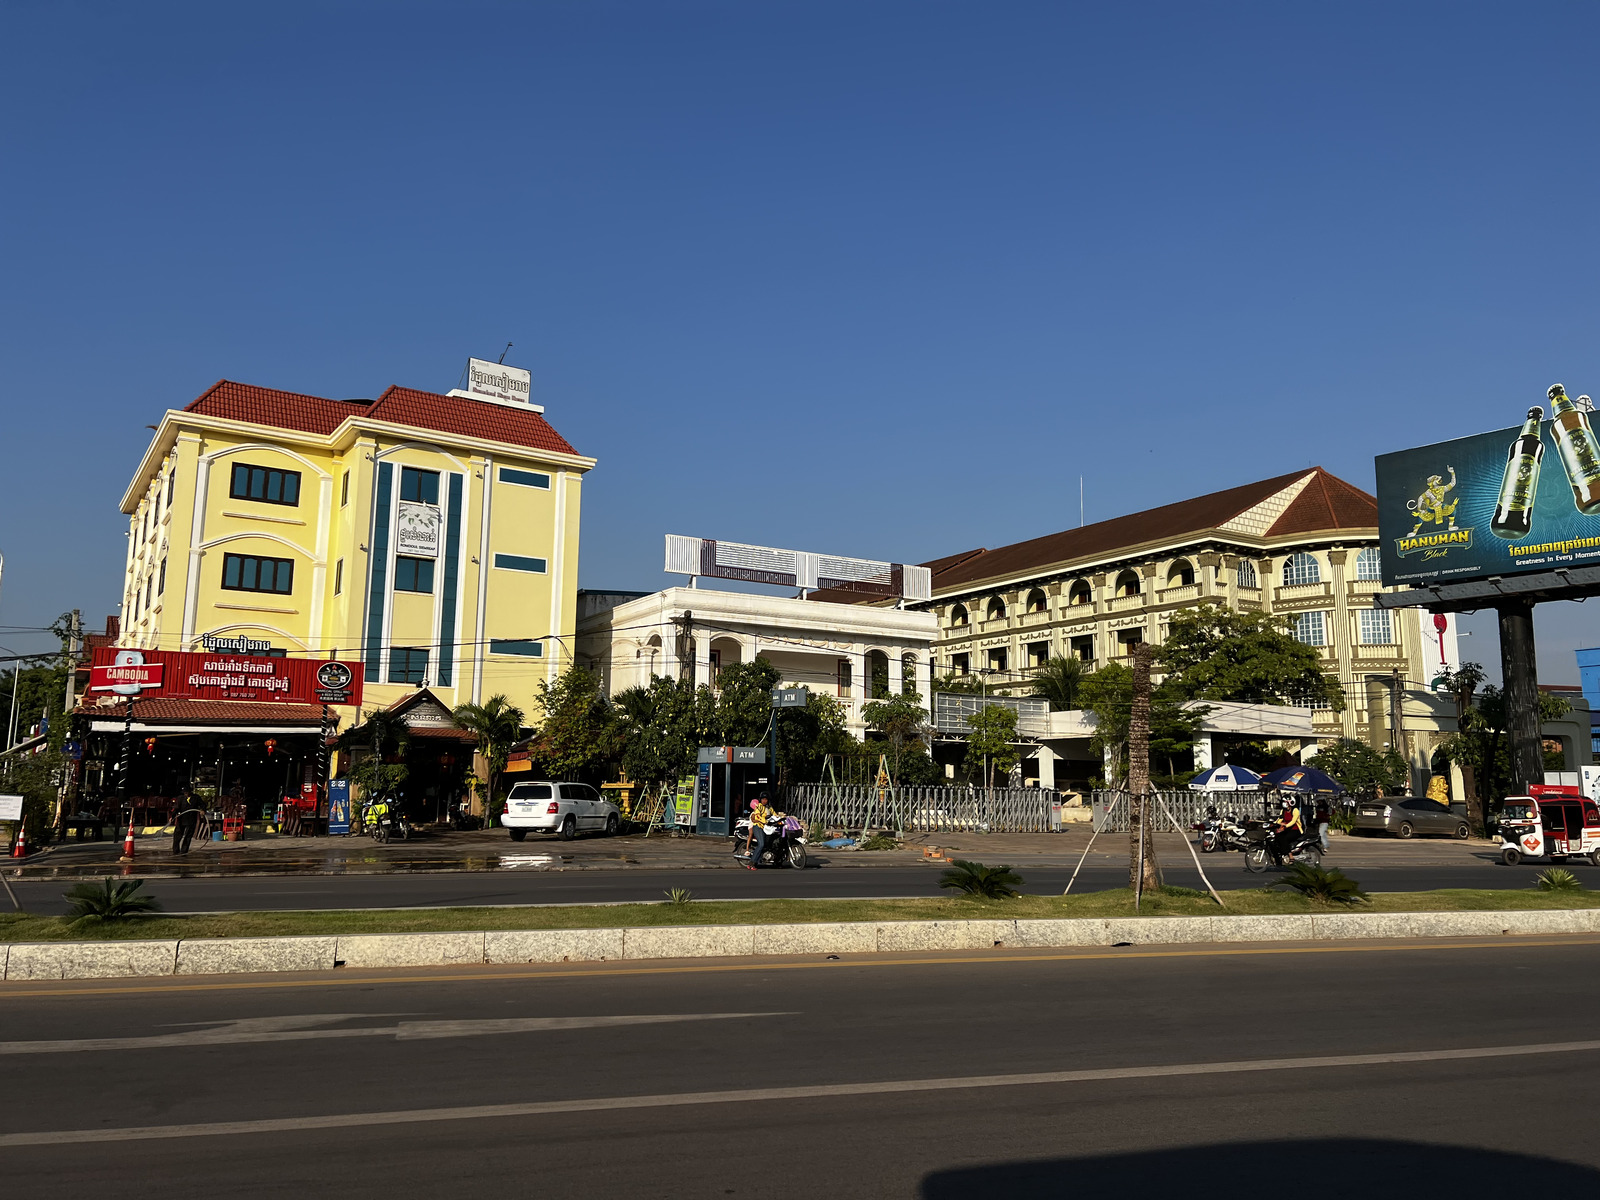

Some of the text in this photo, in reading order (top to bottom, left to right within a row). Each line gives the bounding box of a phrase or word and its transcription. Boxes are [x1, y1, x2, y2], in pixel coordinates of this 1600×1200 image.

[1399, 530, 1469, 551] HANUMAN
[1420, 548, 1448, 562] Black
[1515, 557, 1545, 566] Greatness
[202, 633, 271, 653] រំដួលសៀមរាប
[106, 668, 149, 680] CAMBODIA
[784, 694, 796, 702] ATM
[739, 751, 754, 759] ATM
